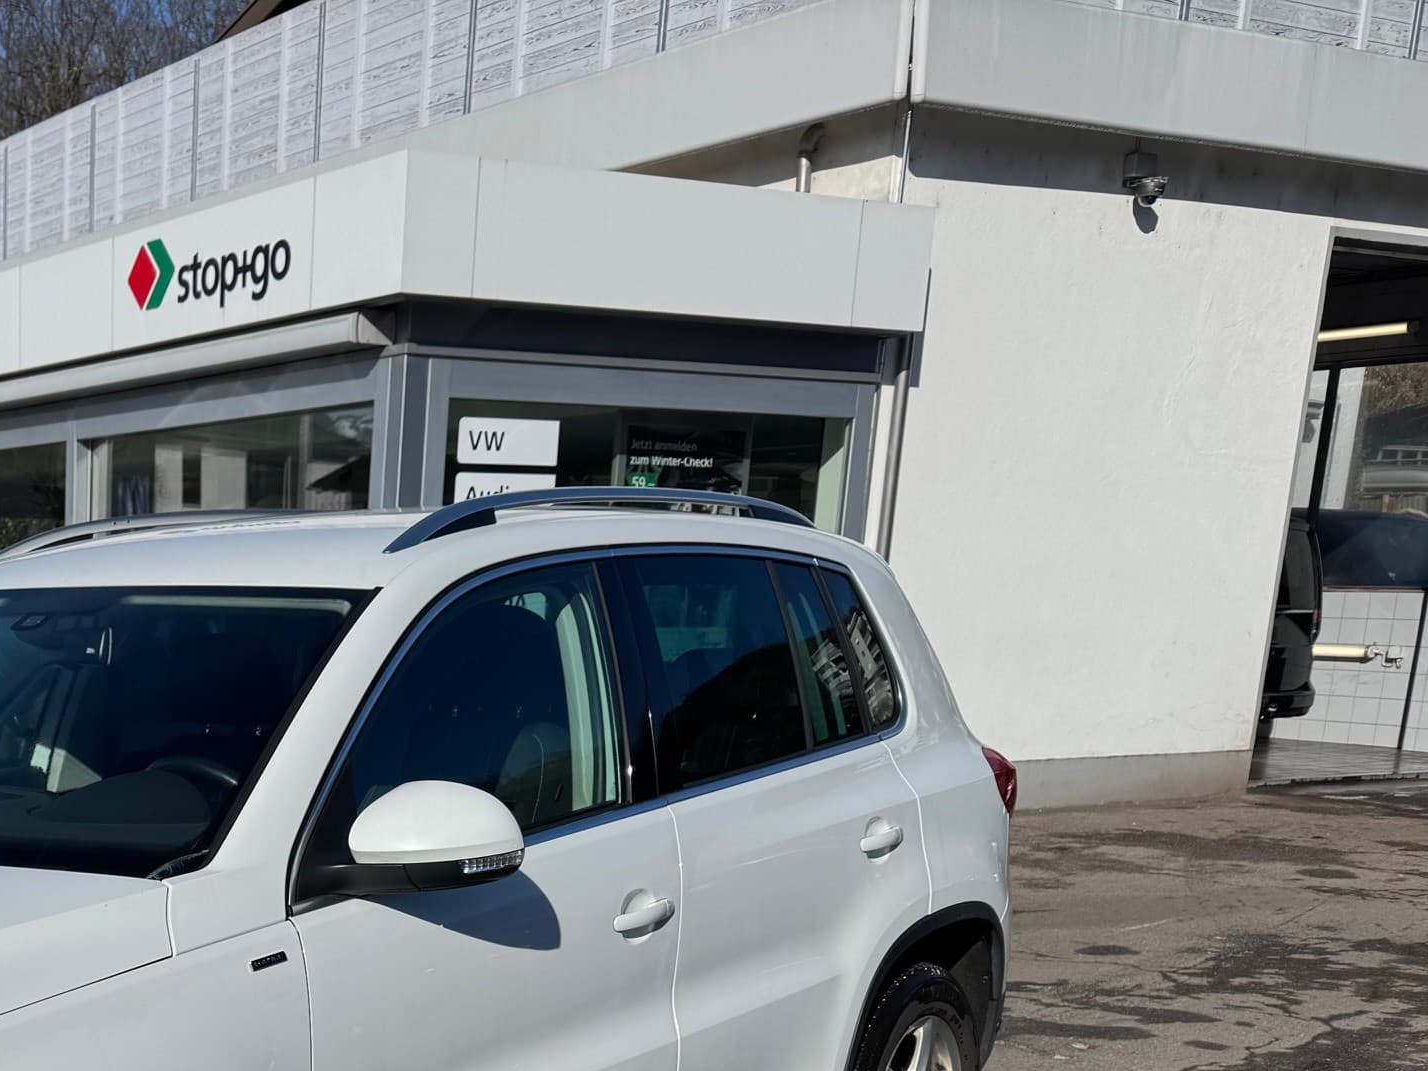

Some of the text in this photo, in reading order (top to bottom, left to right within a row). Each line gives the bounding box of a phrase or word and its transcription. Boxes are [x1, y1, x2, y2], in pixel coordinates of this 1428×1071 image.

[177, 239, 291, 308] stop+go
[469, 430, 505, 451] VW
[629, 455, 714, 468] zum Winter-Check!
